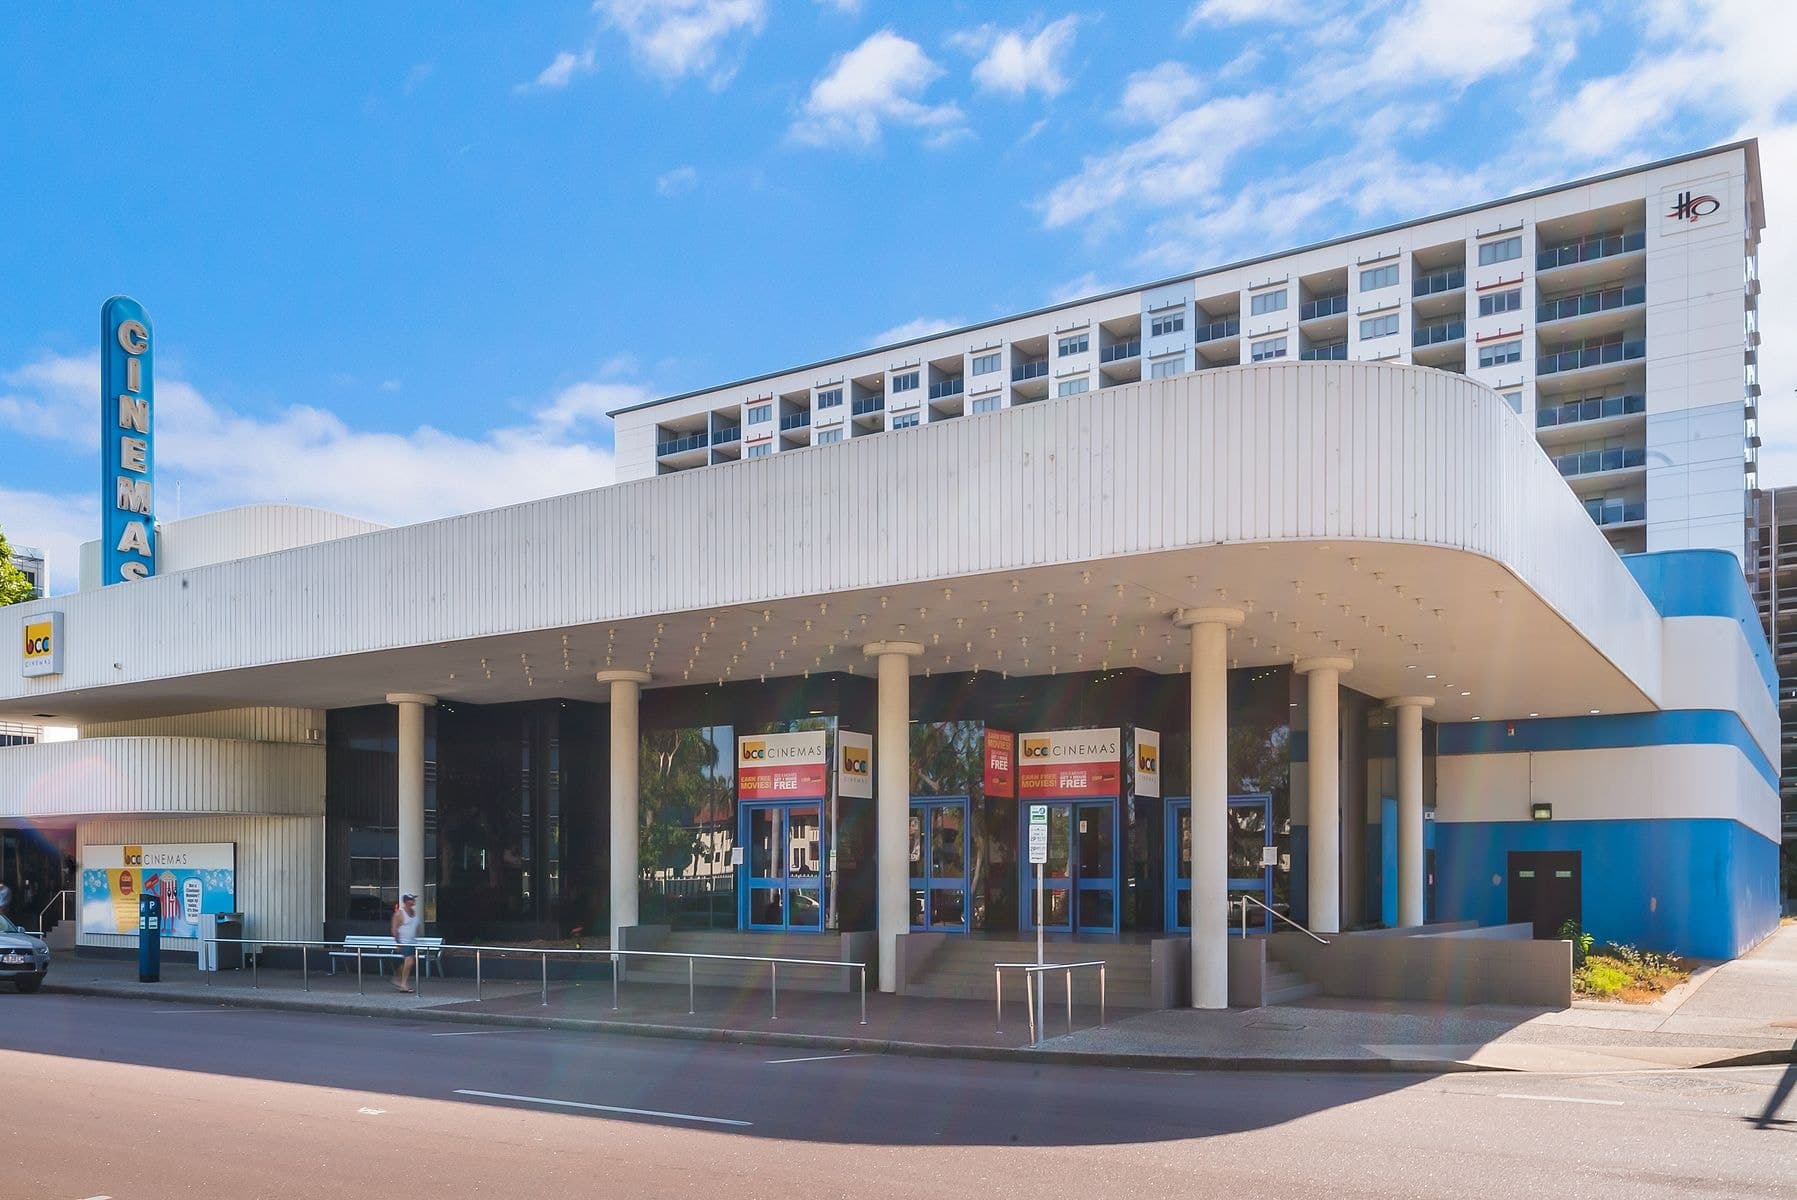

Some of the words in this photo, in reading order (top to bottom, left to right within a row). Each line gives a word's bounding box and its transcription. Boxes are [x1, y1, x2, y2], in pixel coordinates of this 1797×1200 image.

[25, 625, 50, 655] bcc
[743, 742, 764, 760] bcc
[768, 745, 822, 759] CINEMAS
[1024, 739, 1048, 758] bcc
[1053, 743, 1115, 757] CINEMAS
[843, 746, 866, 773] bcc
[1139, 743, 1155, 772] bcc
[990, 759, 1008, 771] FREE
[741, 781, 772, 790] MOVIES!
[774, 780, 798, 790] FREE
[1022, 779, 1057, 788] MOVIES!
[1060, 779, 1087, 788] FREE
[143, 853, 187, 865] CINEMAS
[149, 901, 155, 910] P
